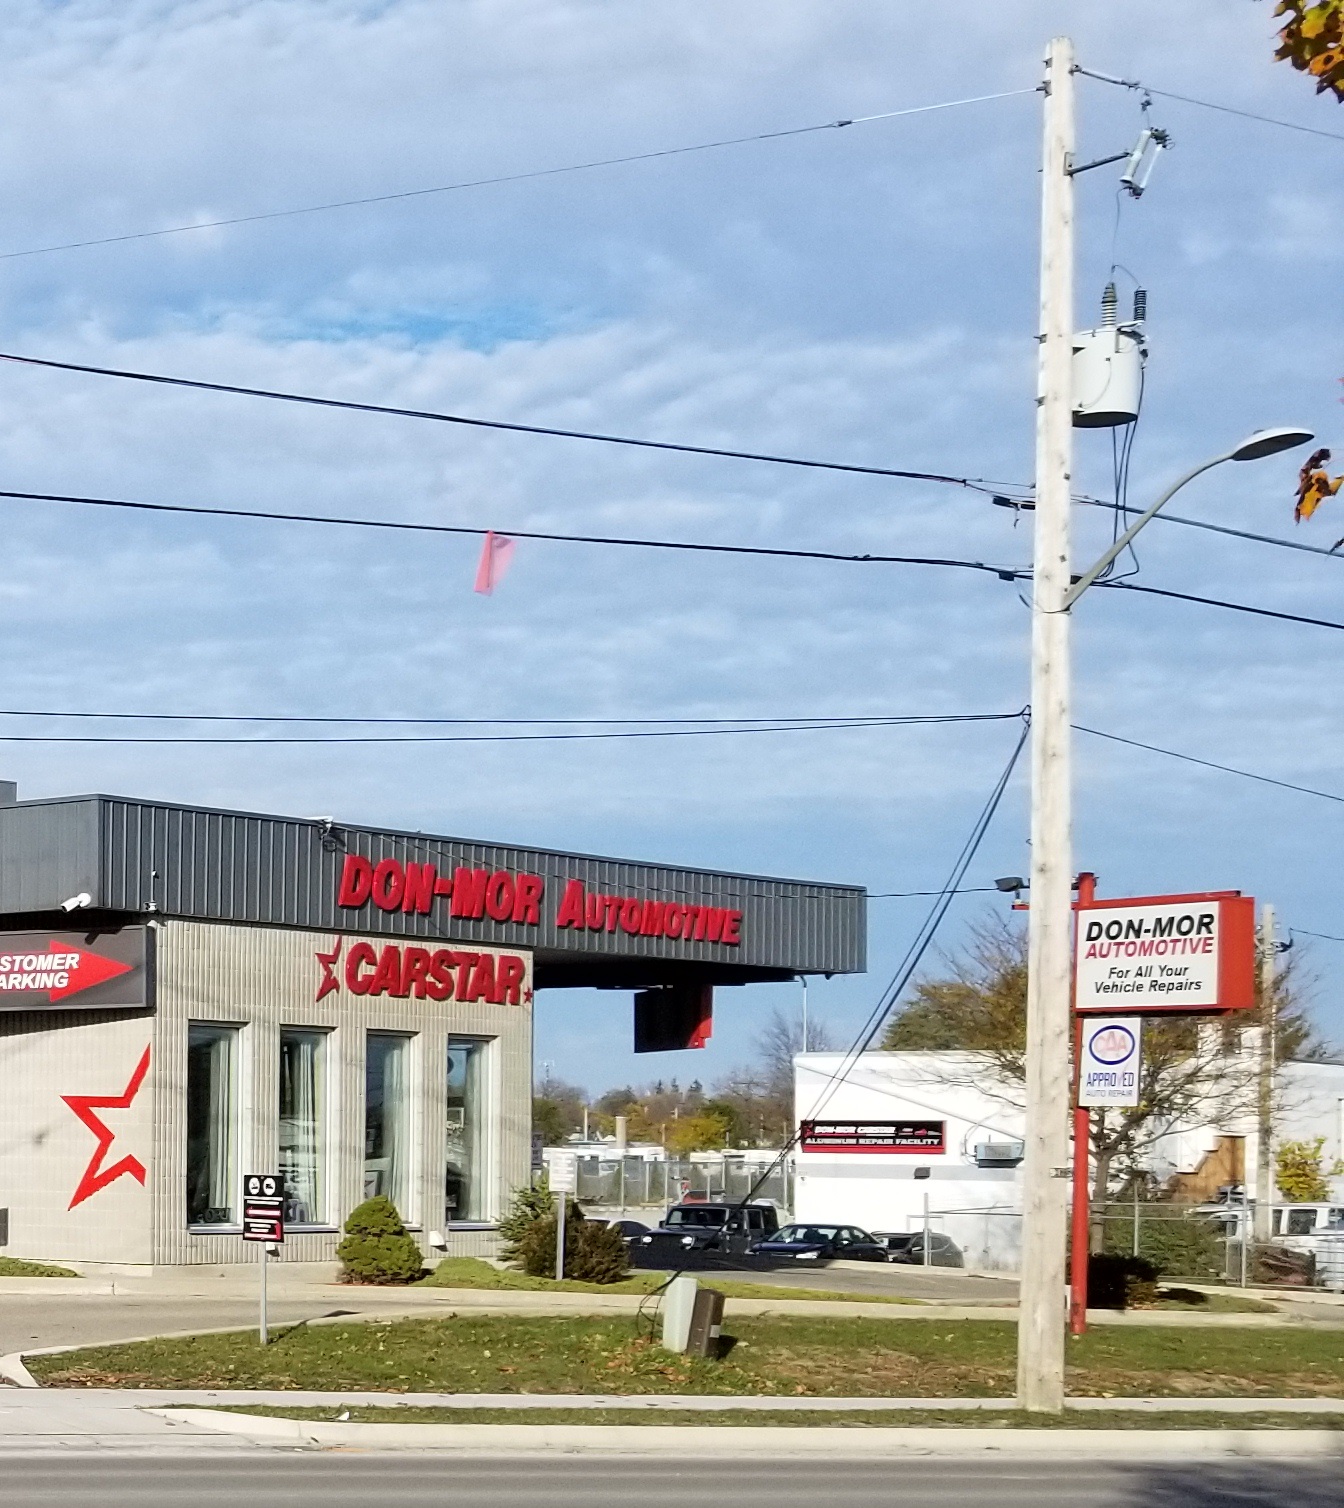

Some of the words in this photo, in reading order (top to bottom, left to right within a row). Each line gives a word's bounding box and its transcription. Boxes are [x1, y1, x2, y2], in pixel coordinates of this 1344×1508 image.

[337, 854, 544, 926] DON-MOR
[556, 878, 743, 946] AUTOMOTIVE
[1085, 913, 1215, 941] DON-MOR
[1085, 936, 1215, 959] AUTOMOTIVE
[345, 942, 526, 1006] CARSTAR
[1108, 966, 1131, 979] For
[1134, 964, 1153, 978] All
[1158, 964, 1190, 977] Your
[1095, 980, 1144, 994] Vehicle
[1148, 978, 1203, 994] Repairs
[1086, 1071, 1135, 1087] APPROED
